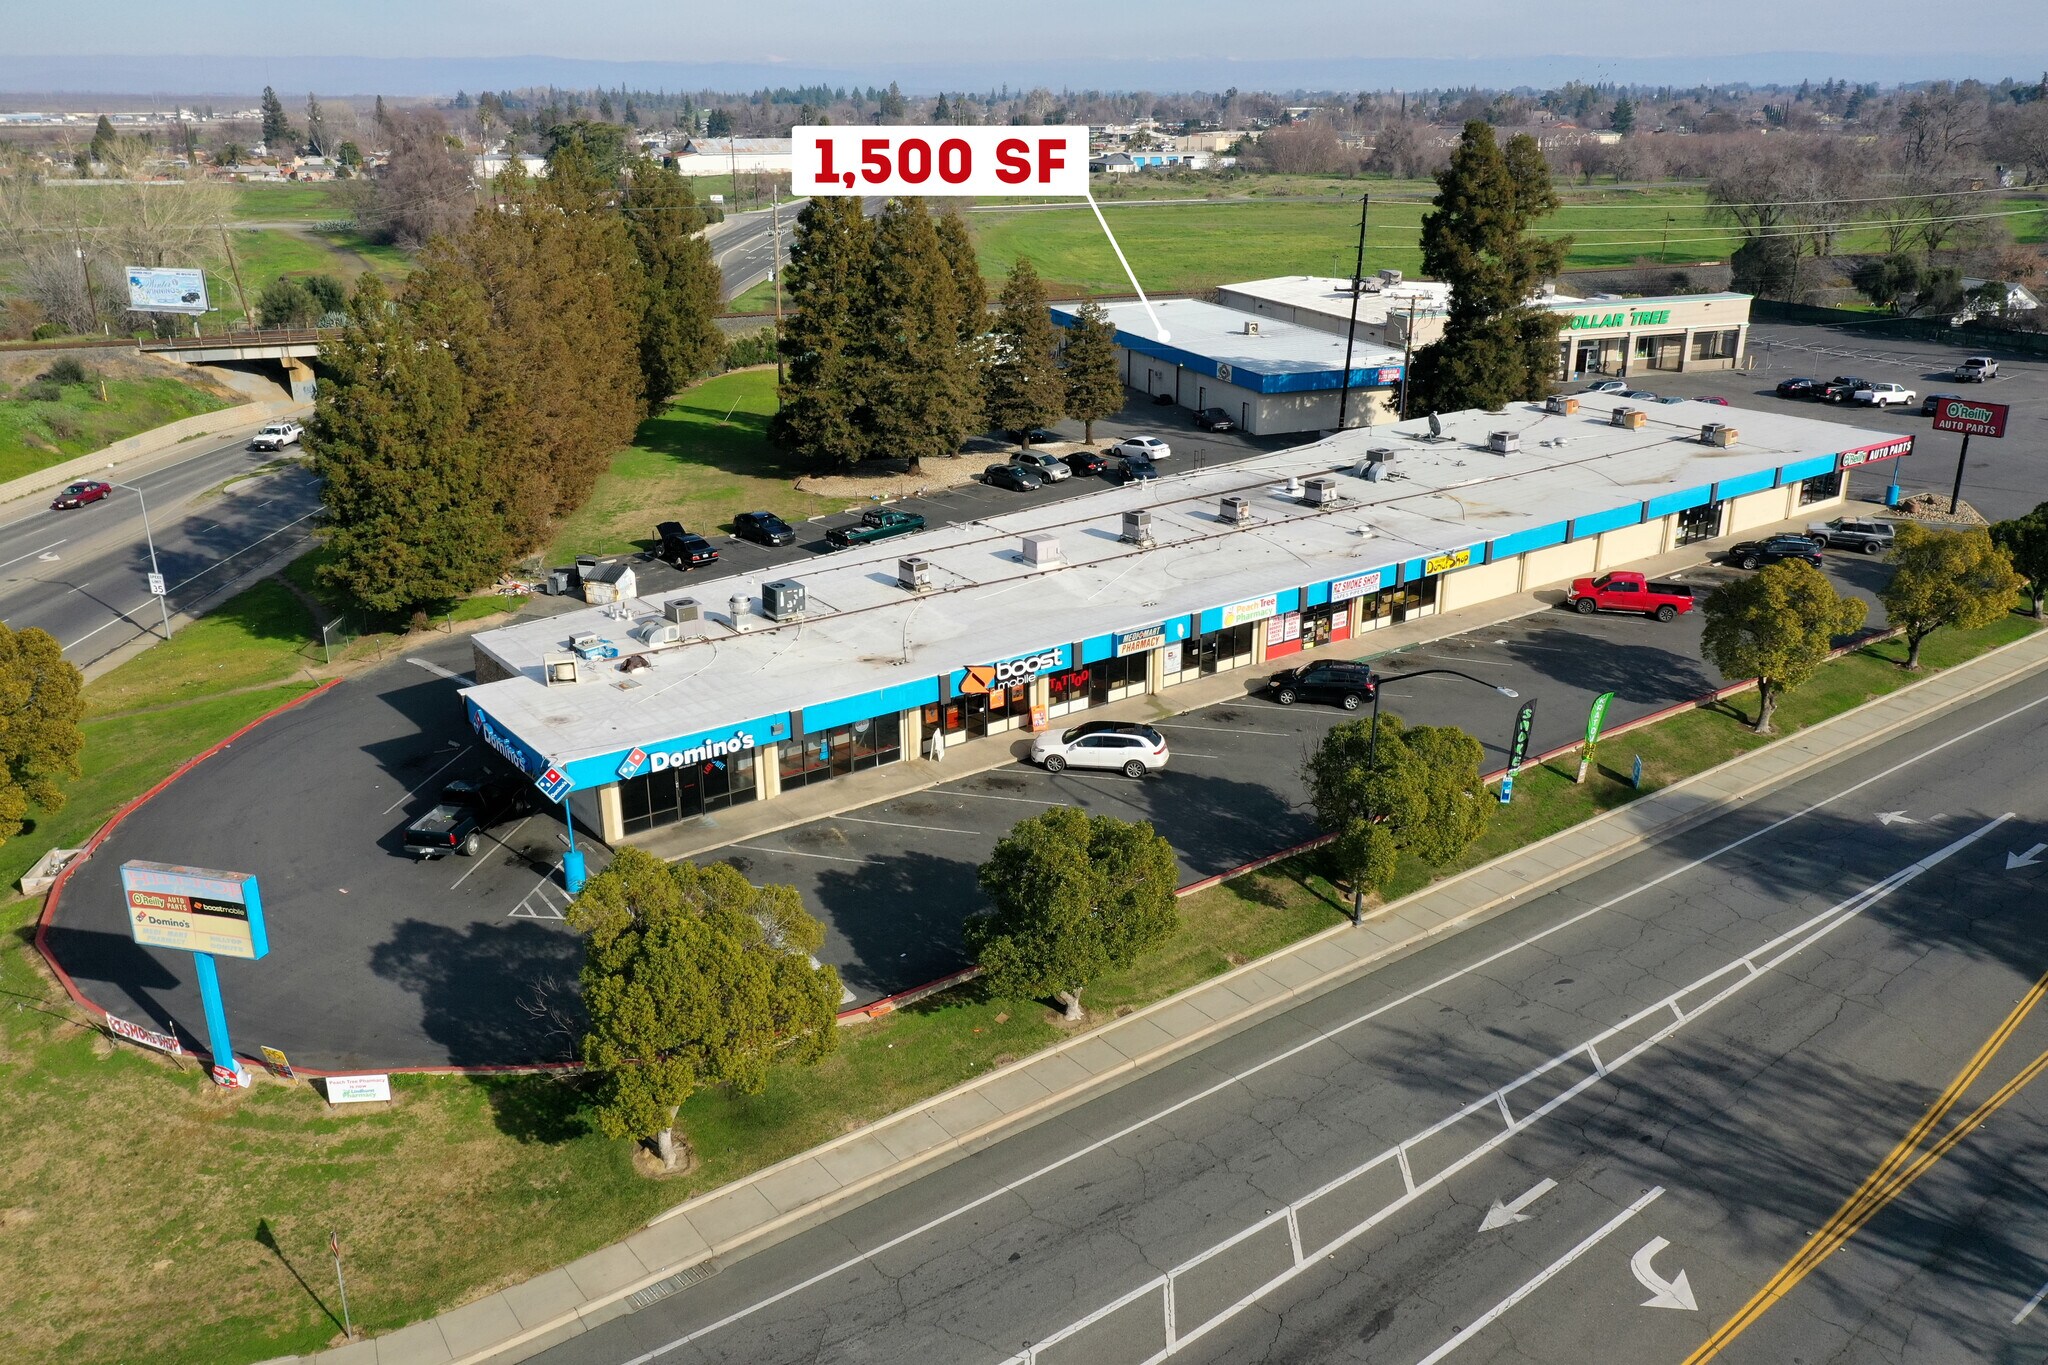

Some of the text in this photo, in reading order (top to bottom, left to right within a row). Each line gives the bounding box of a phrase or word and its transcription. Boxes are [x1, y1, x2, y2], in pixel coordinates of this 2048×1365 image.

[1630, 310, 1671, 326] TREE
[1947, 403, 1993, 423] O'Reilly
[1939, 419, 1996, 435] AUTO PARTS
[1842, 441, 1912, 467] O'Reilly AUTO PARTS
[154, 585, 164, 593] 35
[1342, 577, 1362, 591] SMOKE
[1363, 573, 1379, 586] SHOP
[1236, 597, 1275, 613] Peach Tree
[1236, 607, 1273, 622] Pharmacy
[1143, 626, 1161, 638] MART
[1121, 636, 1160, 653] PHARMACY
[996, 648, 1063, 680] boost
[997, 673, 1036, 690] mobile
[1050, 669, 1089, 692] TATTOO
[1511, 708, 1533, 767] SMOKE
[483, 723, 526, 773] Domino's
[650, 731, 755, 773] Domino's
[132, 892, 165, 908] O'Reilly
[166, 903, 187, 911] PARTS
[167, 896, 184, 904] AUTO
[148, 915, 190, 928] Domino's
